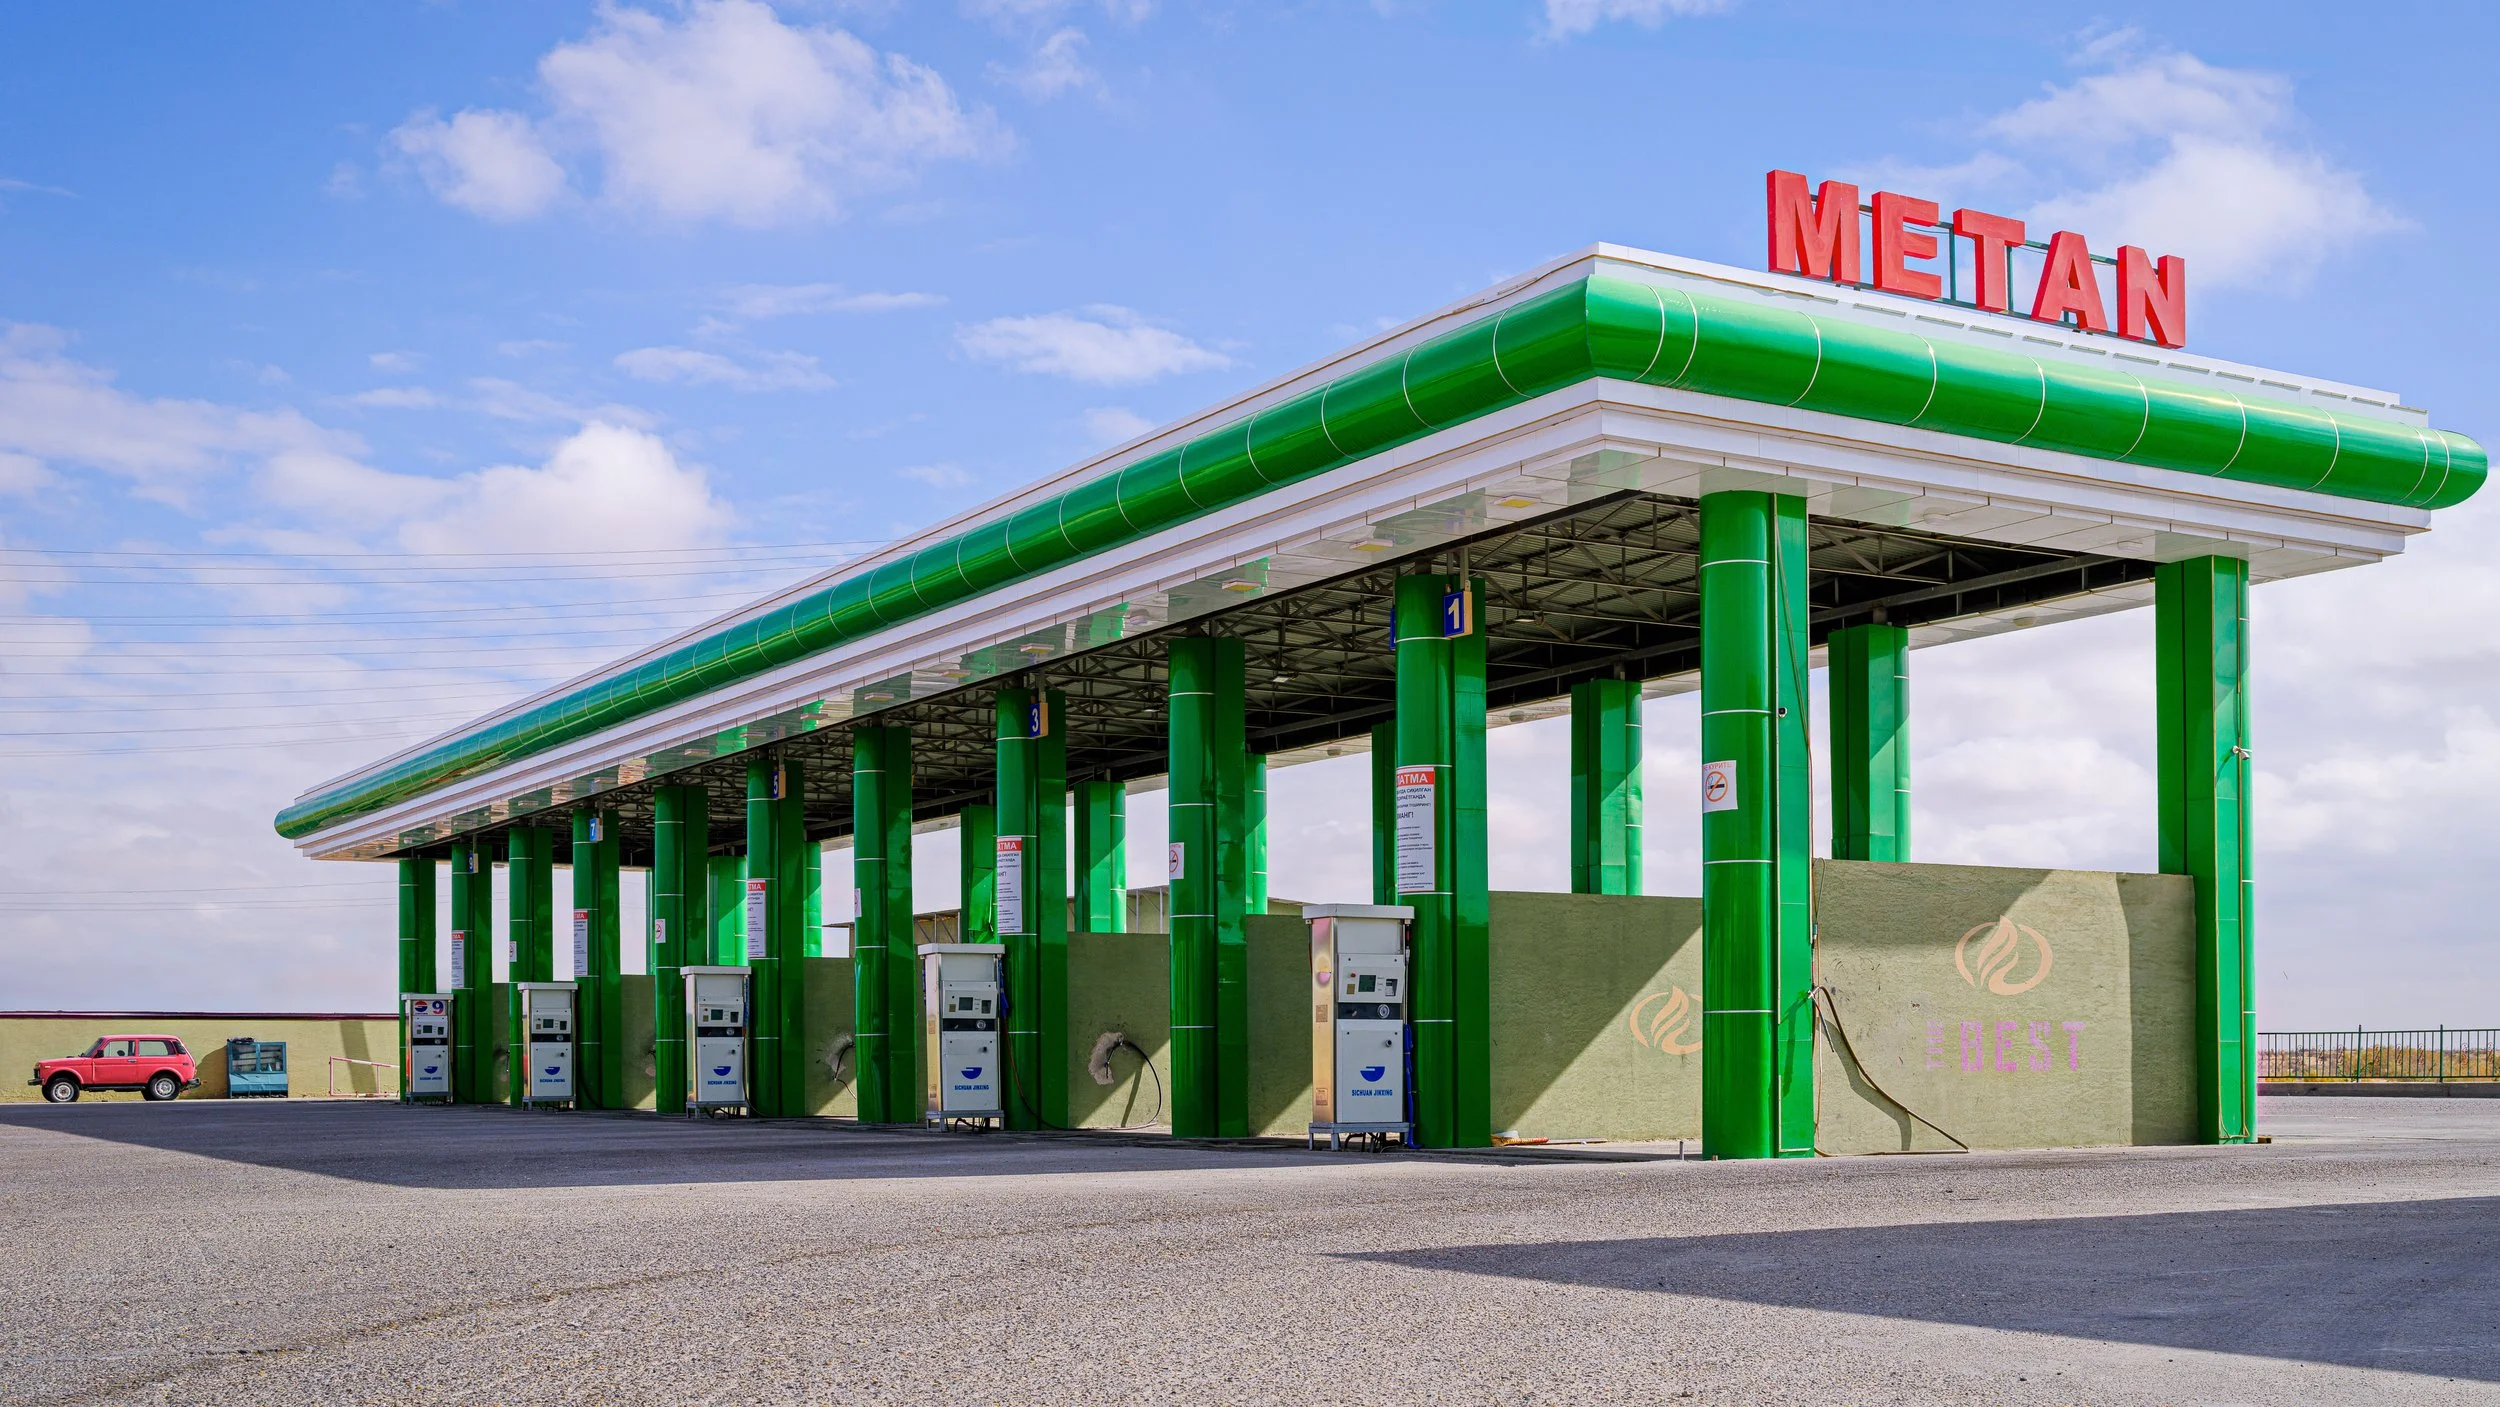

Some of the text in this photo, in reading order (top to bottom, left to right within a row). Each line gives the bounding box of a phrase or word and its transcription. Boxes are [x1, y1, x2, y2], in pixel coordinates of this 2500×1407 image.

[1766, 169, 2185, 349] METAN
[1448, 598, 1460, 630] 1
[1032, 708, 1039, 732] 3
[773, 775, 779, 795] 5
[432, 1000, 444, 1014] 9
[1960, 1020, 2085, 1073] BEST
[1351, 1089, 1373, 1097] SICHUAN
